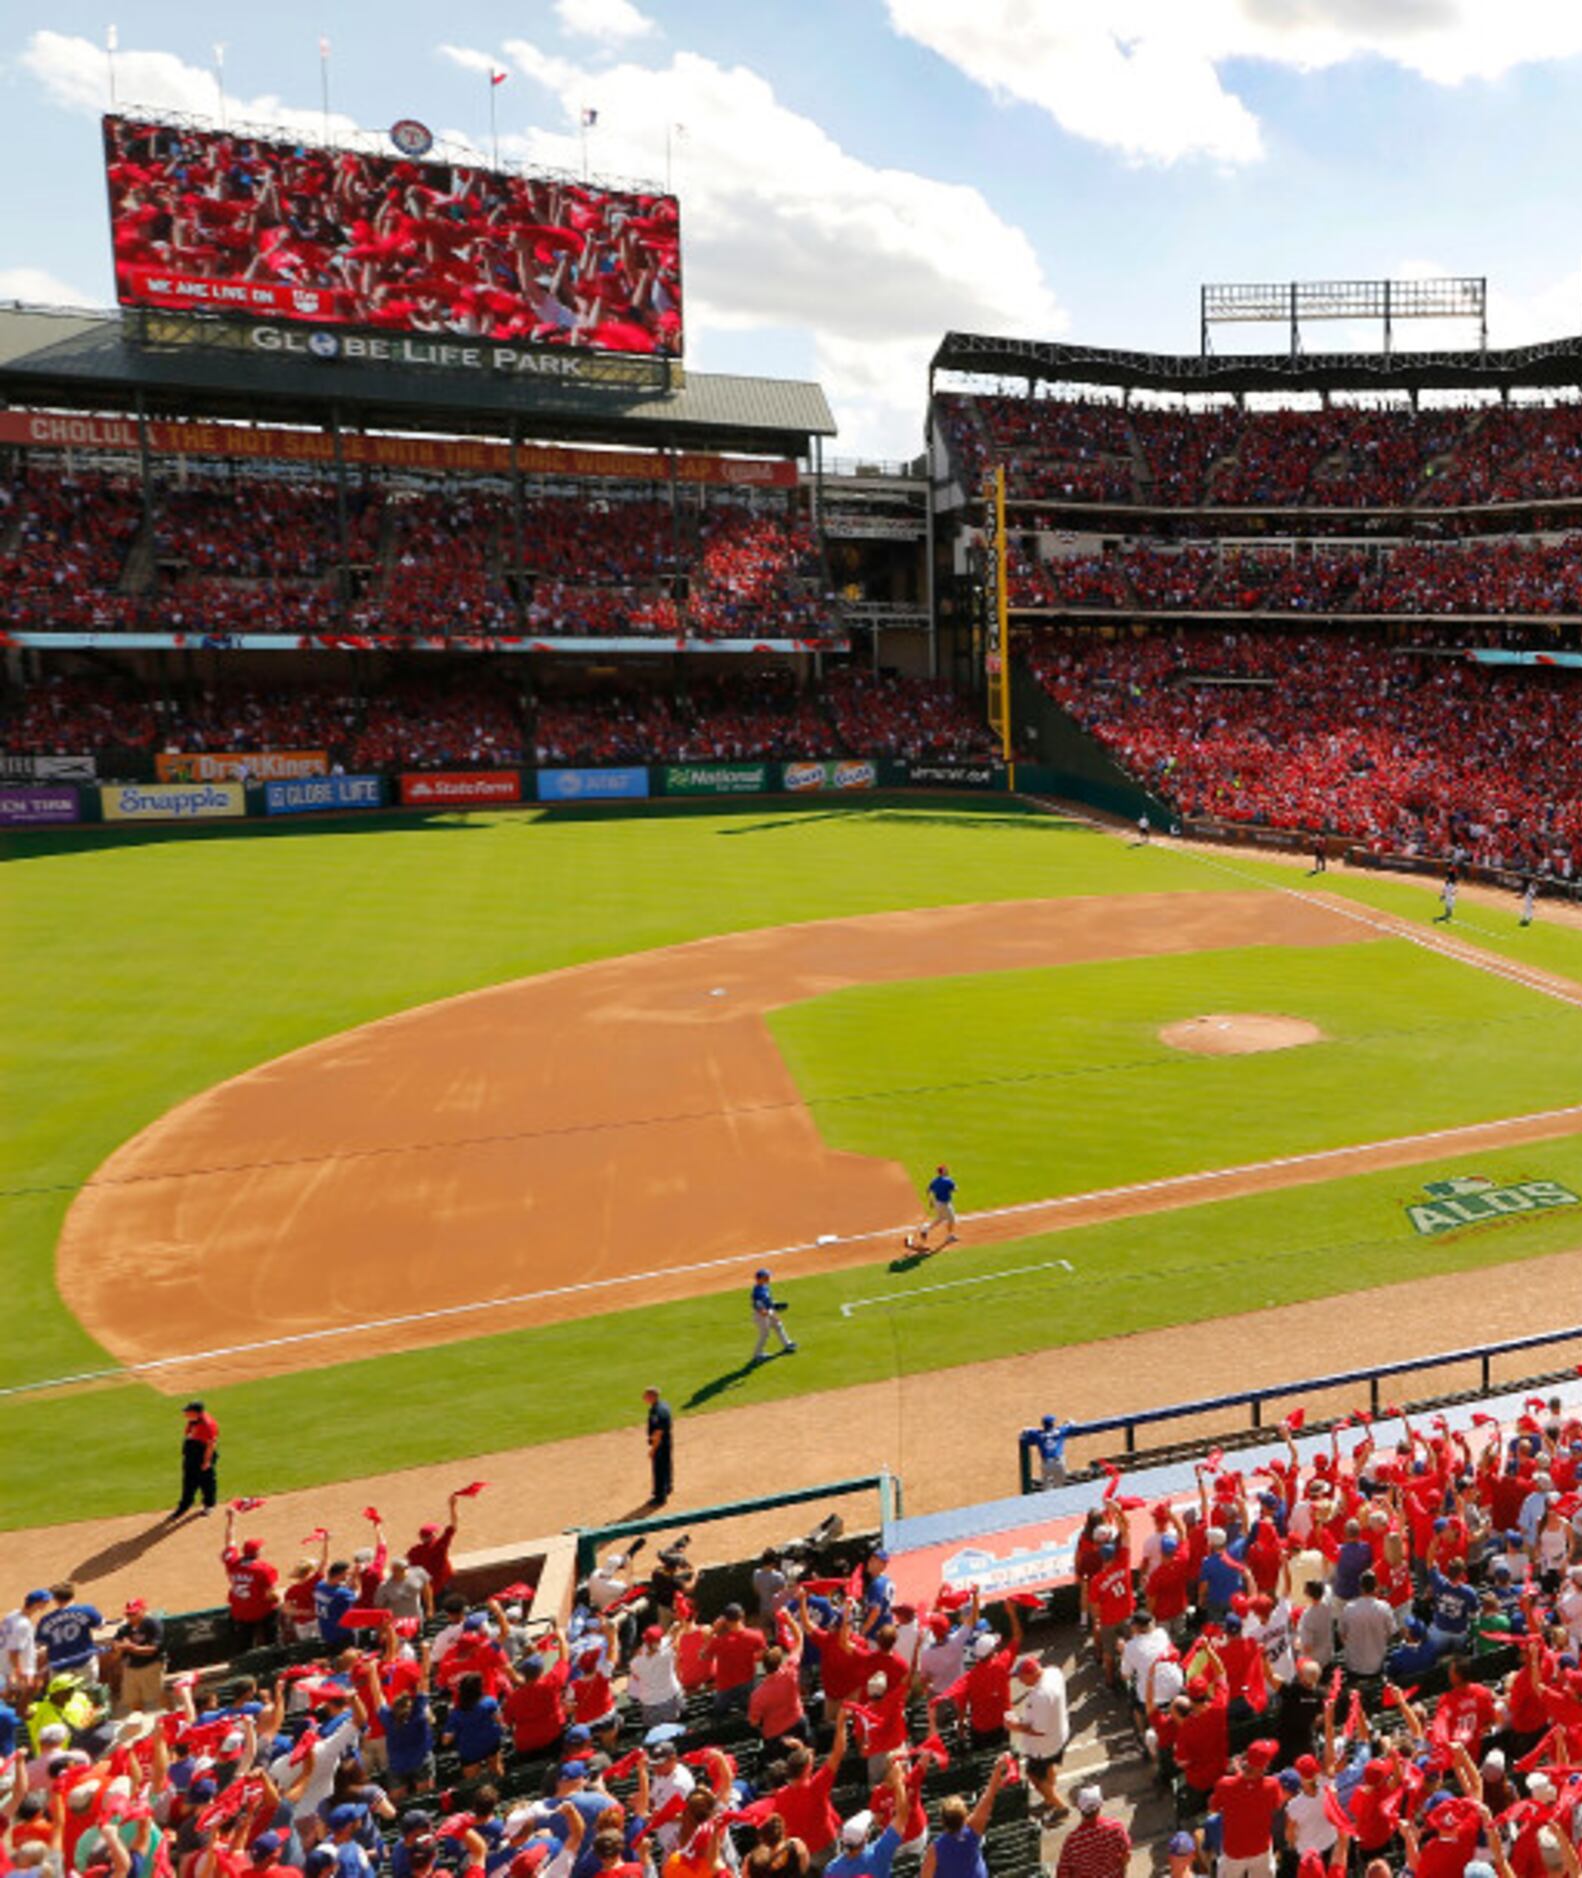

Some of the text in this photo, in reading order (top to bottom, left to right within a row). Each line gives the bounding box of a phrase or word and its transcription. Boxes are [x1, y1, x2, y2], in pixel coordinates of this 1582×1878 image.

[147, 278, 274, 304] WE ARE LIVE ON
[402, 338, 481, 369] LIFE
[493, 347, 582, 376] PARK
[167, 428, 217, 450] THE
[226, 430, 272, 454] HOT
[691, 768, 763, 786] National
[119, 786, 231, 814] Snapple
[286, 778, 380, 805] GLOBE LIFE
[1407, 1181, 1581, 1236] ALDS
[52, 1623, 81, 1644] 10
